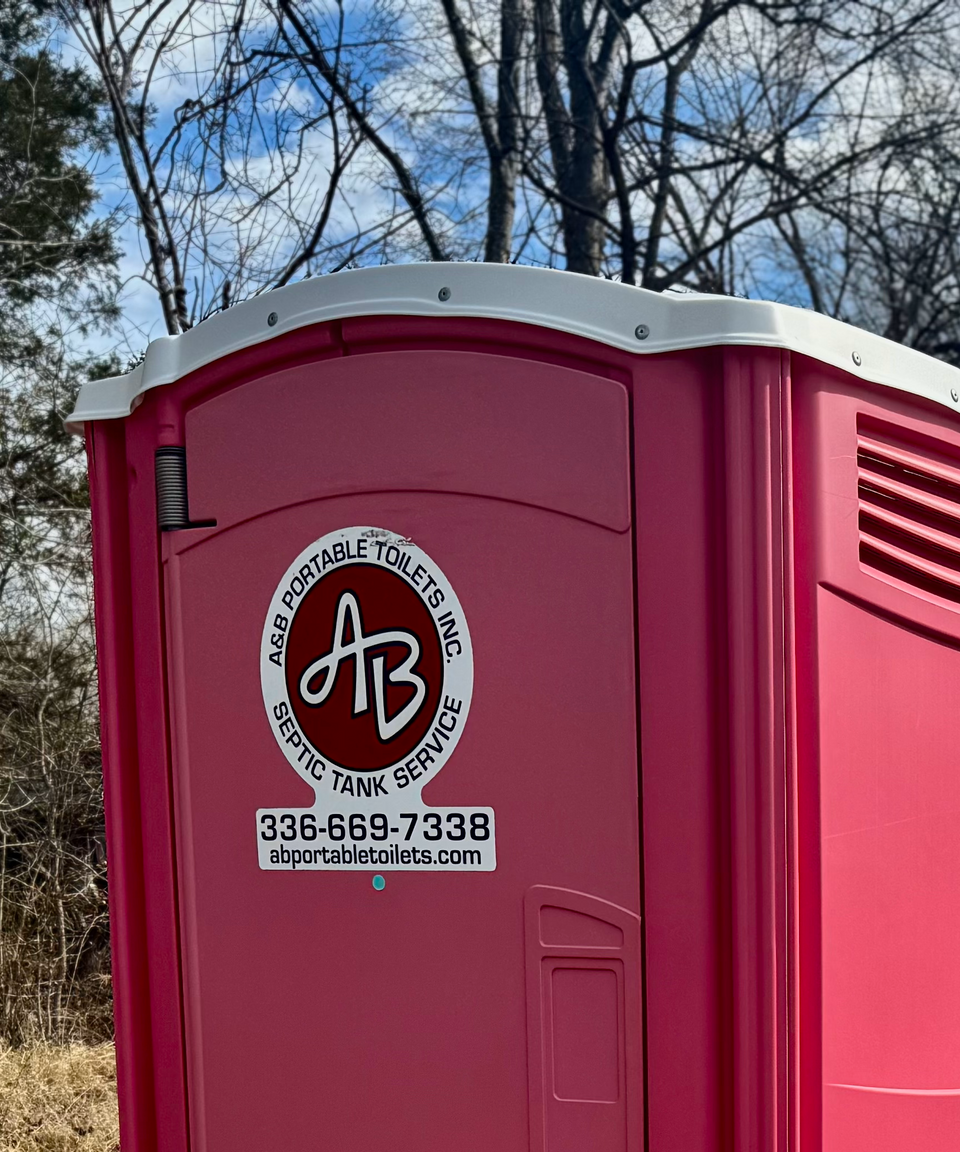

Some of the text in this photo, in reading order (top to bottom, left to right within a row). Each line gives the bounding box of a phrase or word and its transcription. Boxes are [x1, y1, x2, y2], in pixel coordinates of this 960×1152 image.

[269, 538, 463, 667] A&B PORTABLE TOILETS INC.
[273, 695, 463, 797] SEPTIC TANK SERVICE
[260, 813, 490, 842] 336-669-7338
[269, 844, 482, 869] abportabletoilets.com
